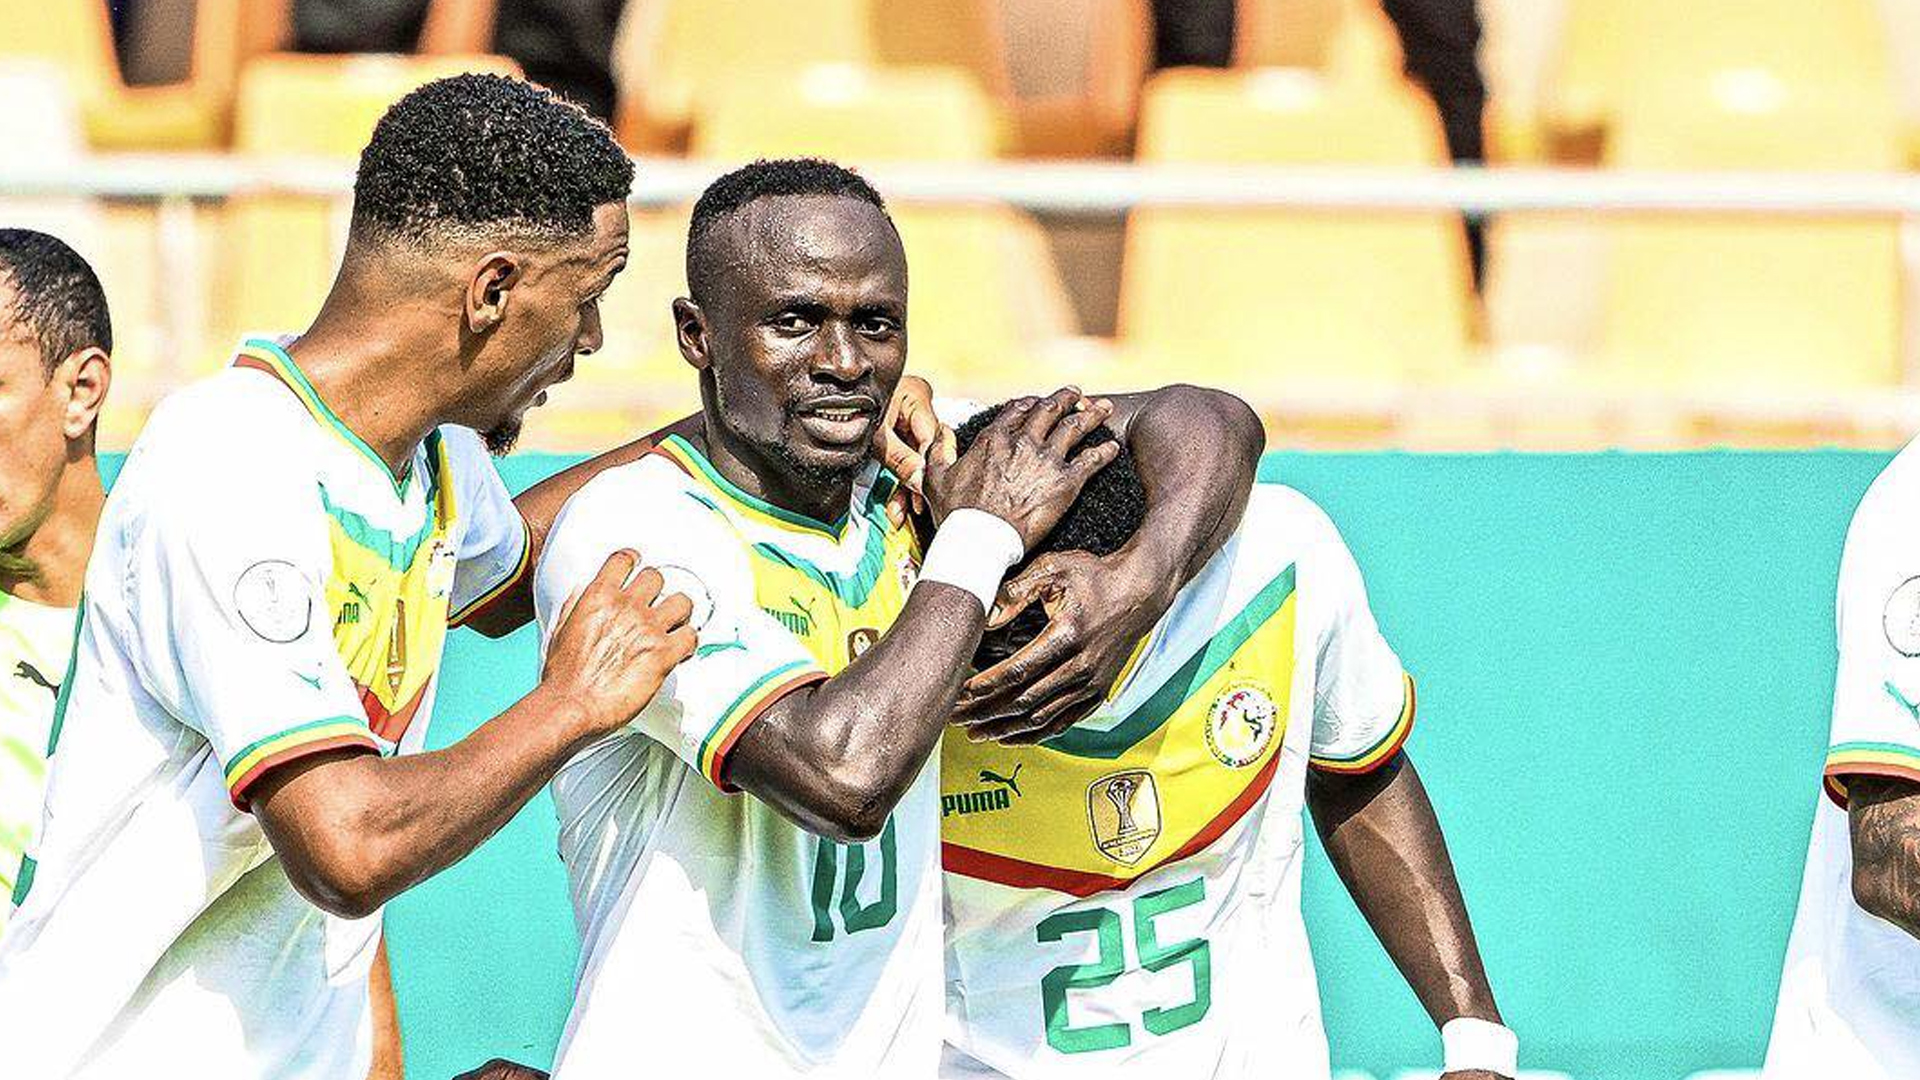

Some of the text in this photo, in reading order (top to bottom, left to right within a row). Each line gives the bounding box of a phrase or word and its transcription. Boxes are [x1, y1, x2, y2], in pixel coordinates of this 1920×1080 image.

[941, 788, 1011, 817] PUMA
[810, 810, 898, 942] 10
[1036, 876, 1211, 1055] 25
